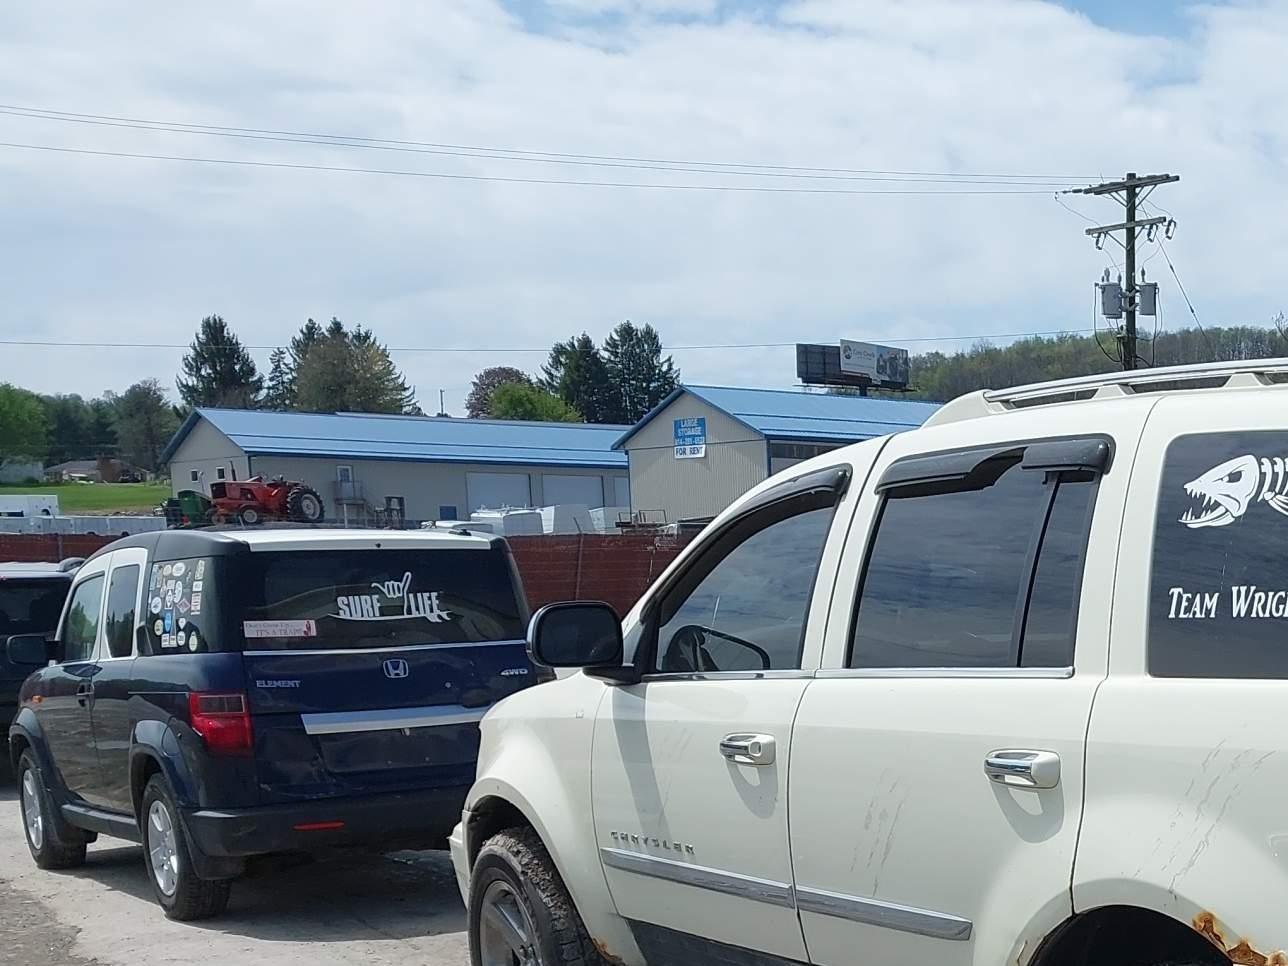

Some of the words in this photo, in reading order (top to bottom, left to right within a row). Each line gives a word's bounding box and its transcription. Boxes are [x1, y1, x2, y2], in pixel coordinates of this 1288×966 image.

[675, 447, 687, 456] FOR
[689, 447, 703, 455] RENT
[337, 594, 382, 618] SURF
[408, 592, 441, 617] LIFE
[1168, 587, 1220, 619] TEAM
[500, 667, 528, 675] 4WD
[255, 680, 301, 688] ELEMENT
[610, 831, 696, 855] CHRYSLER
